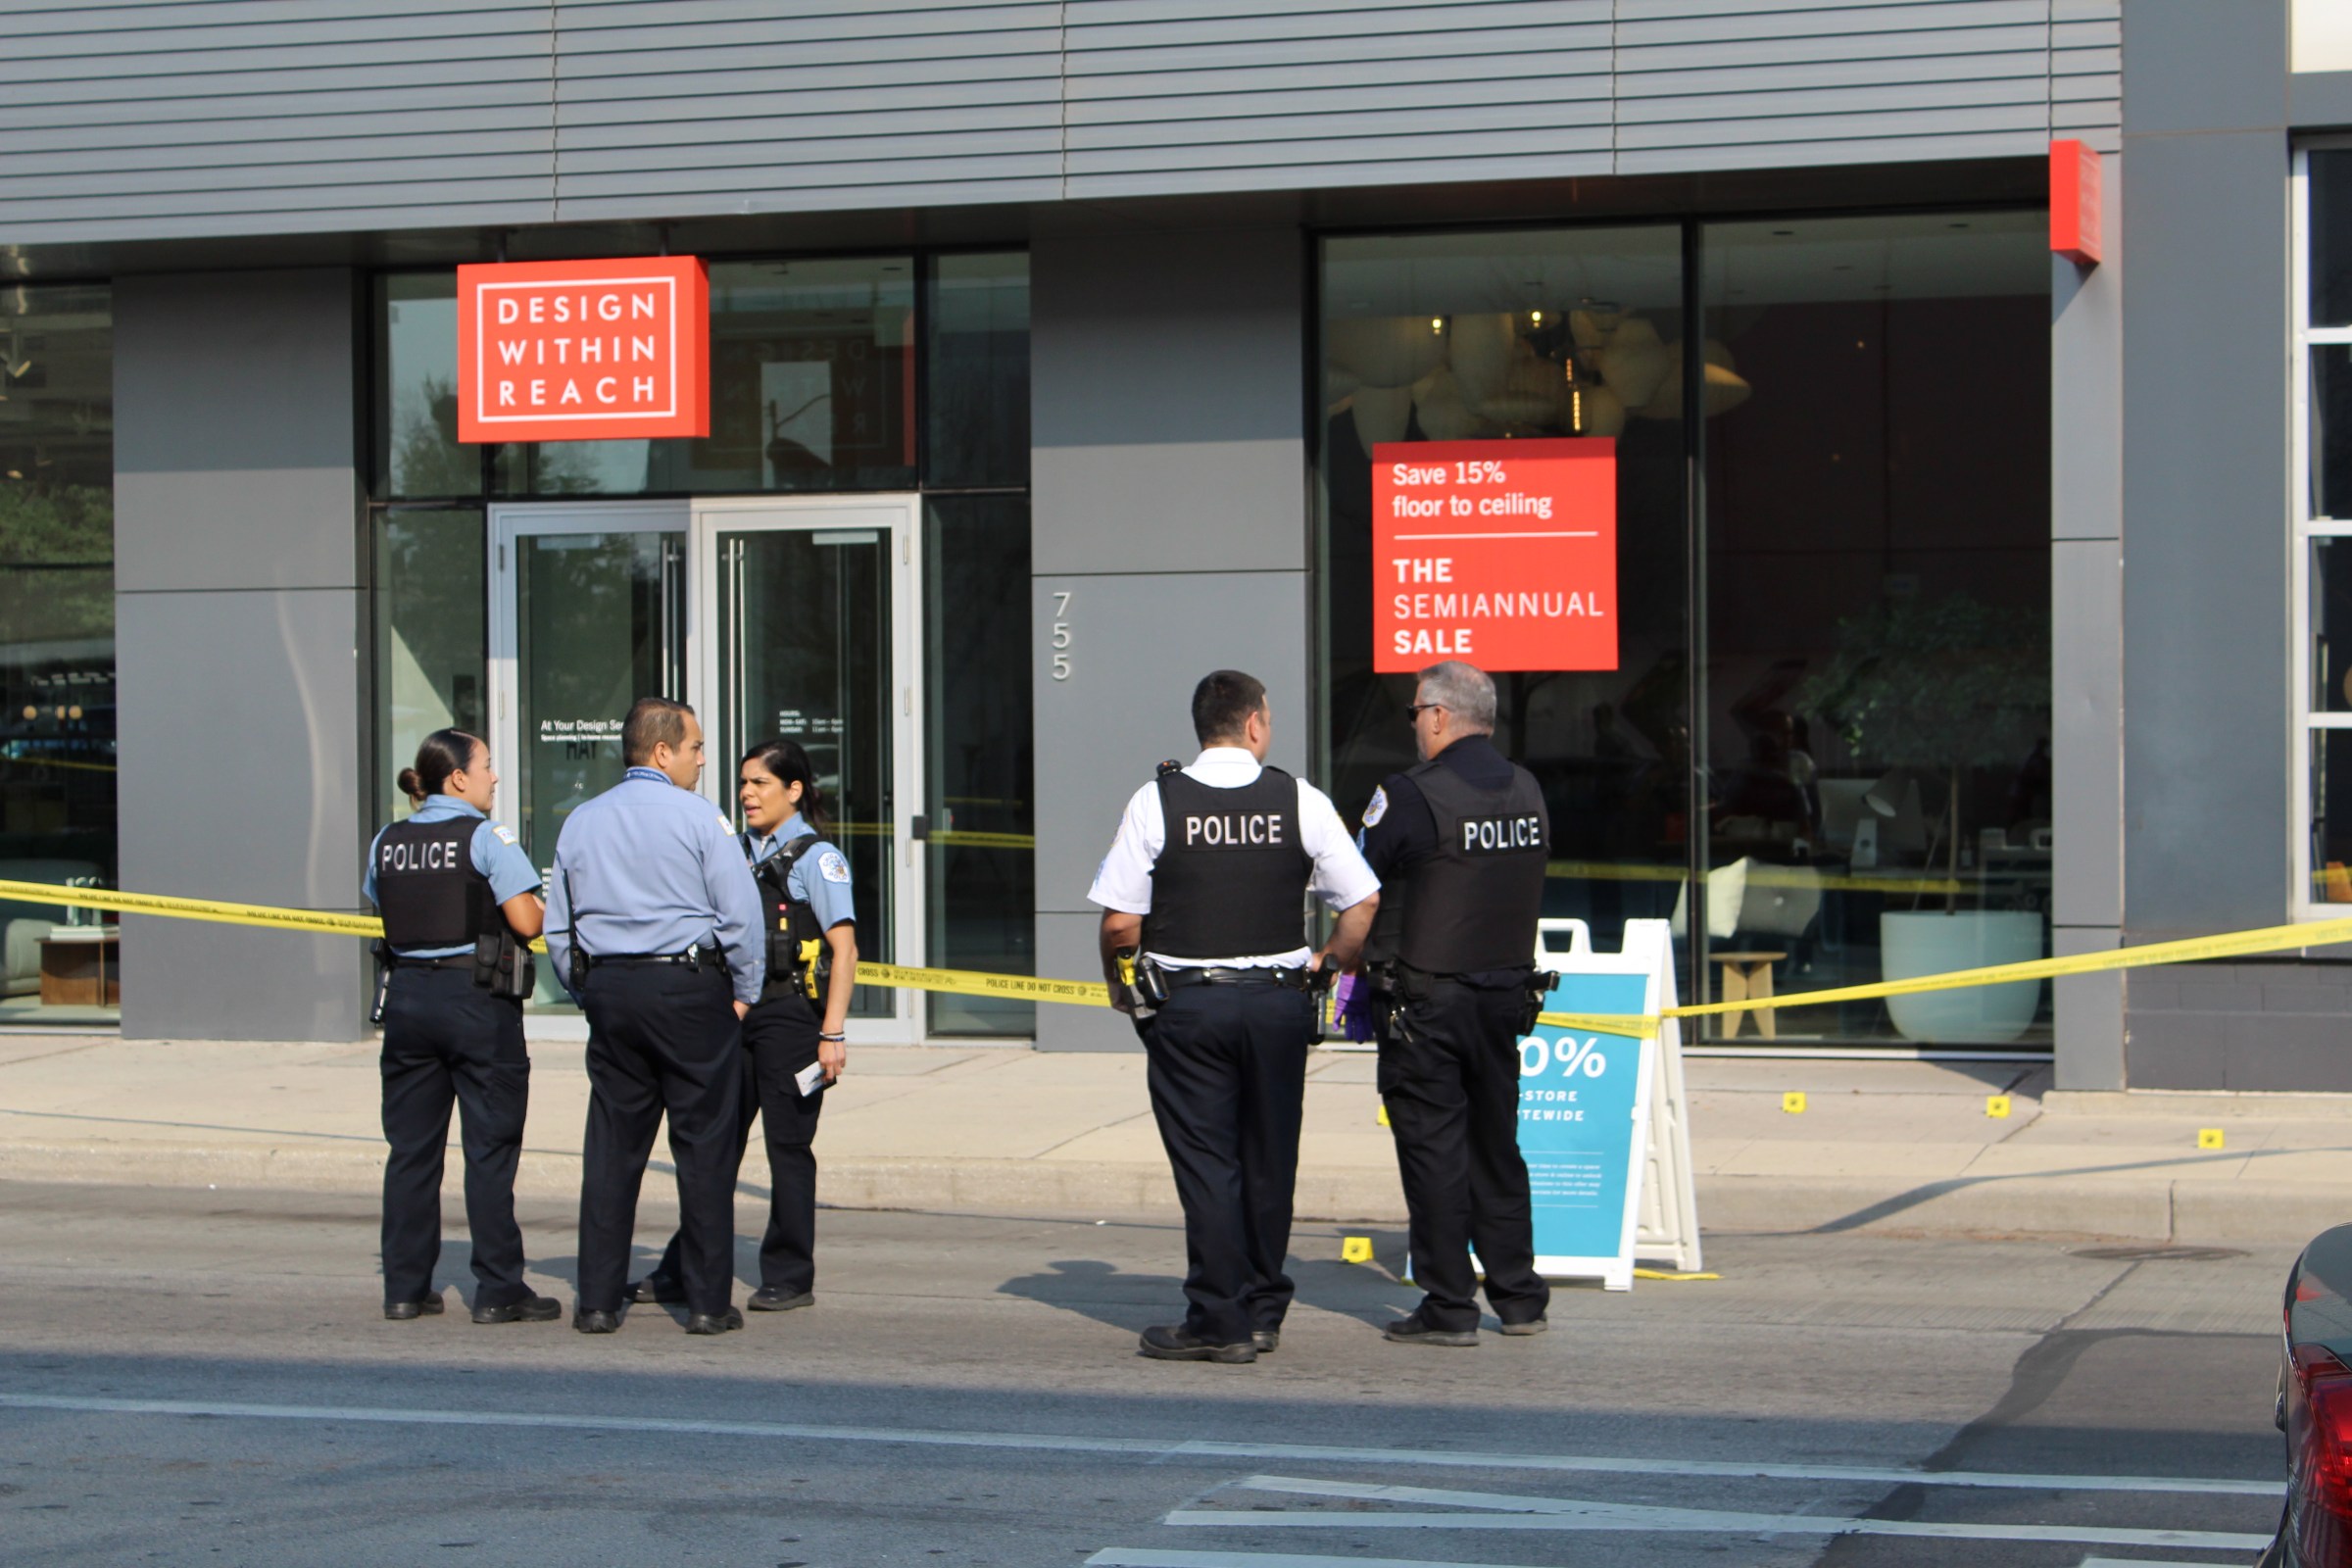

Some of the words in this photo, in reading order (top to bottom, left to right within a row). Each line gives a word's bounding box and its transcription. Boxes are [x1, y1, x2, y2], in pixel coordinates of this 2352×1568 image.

[497, 292, 655, 325] DESIGN
[497, 334, 655, 367] WITHIN
[499, 375, 655, 407] REACH
[1392, 463, 1447, 486] Save
[1454, 460, 1507, 485] 15%
[1392, 494, 1445, 517] floor
[1449, 494, 1473, 516] to
[1478, 492, 1553, 519] ceiling
[1392, 557, 1454, 583] THE
[1393, 591, 1604, 619] SEMIANNUAL
[1052, 591, 1072, 680] 755
[1393, 628, 1474, 655] SALE
[540, 719, 552, 731] At
[554, 719, 575, 731] Your
[576, 719, 607, 733] Design
[1186, 813, 1283, 846] POLICE
[1463, 816, 1541, 851] POLICE
[381, 841, 459, 872] POLICE
[858, 966, 879, 978] CROSS
[986, 978, 1008, 989] POLICE
[1010, 979, 1025, 991] LINE
[1027, 981, 1036, 992] DO
[1038, 983, 1052, 993] NOT
[1053, 984, 1075, 995] CROSS
[1517, 1109, 1585, 1122] TEWIDE
